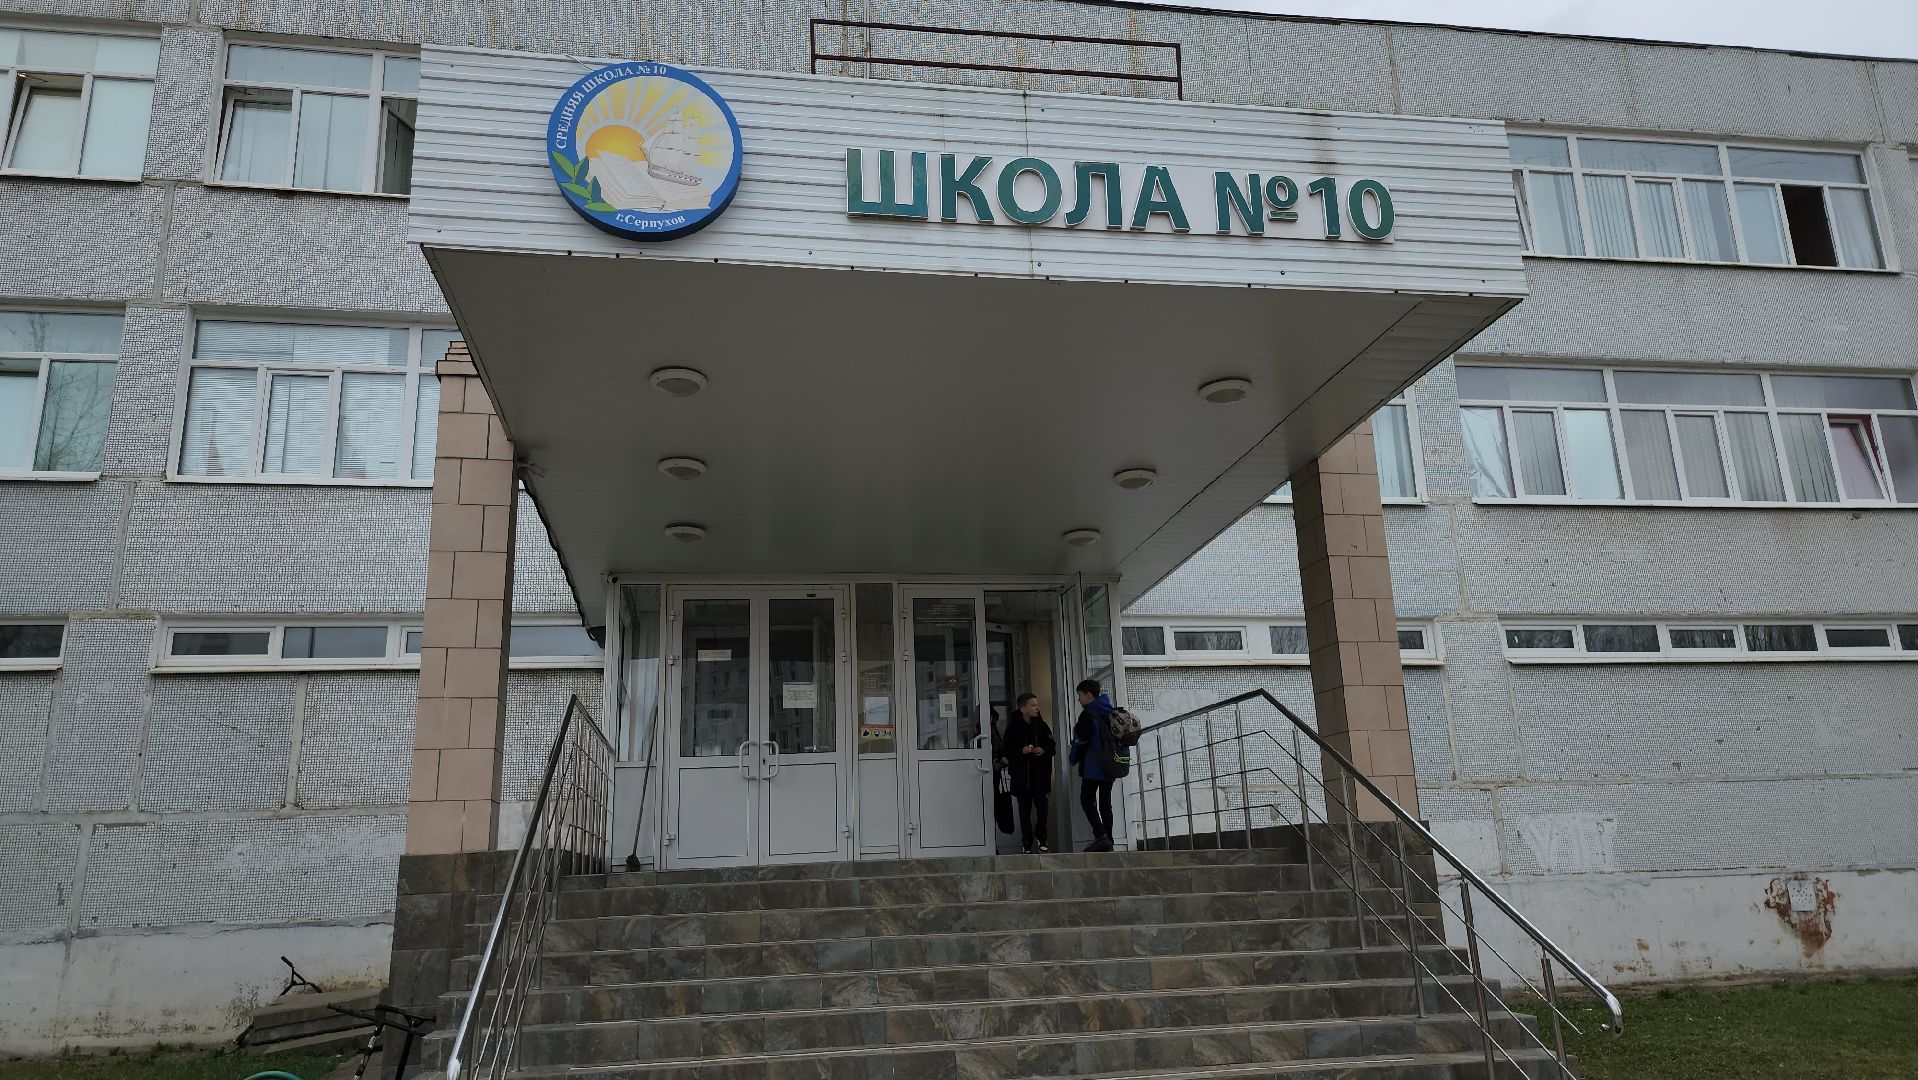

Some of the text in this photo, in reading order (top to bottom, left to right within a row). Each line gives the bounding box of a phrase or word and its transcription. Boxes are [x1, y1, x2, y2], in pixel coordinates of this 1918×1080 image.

[556, 91, 585, 149] СРЕДНЯЯ
[582, 66, 633, 93] ШКОЛА
[845, 147, 1191, 233] ШКОЛА
